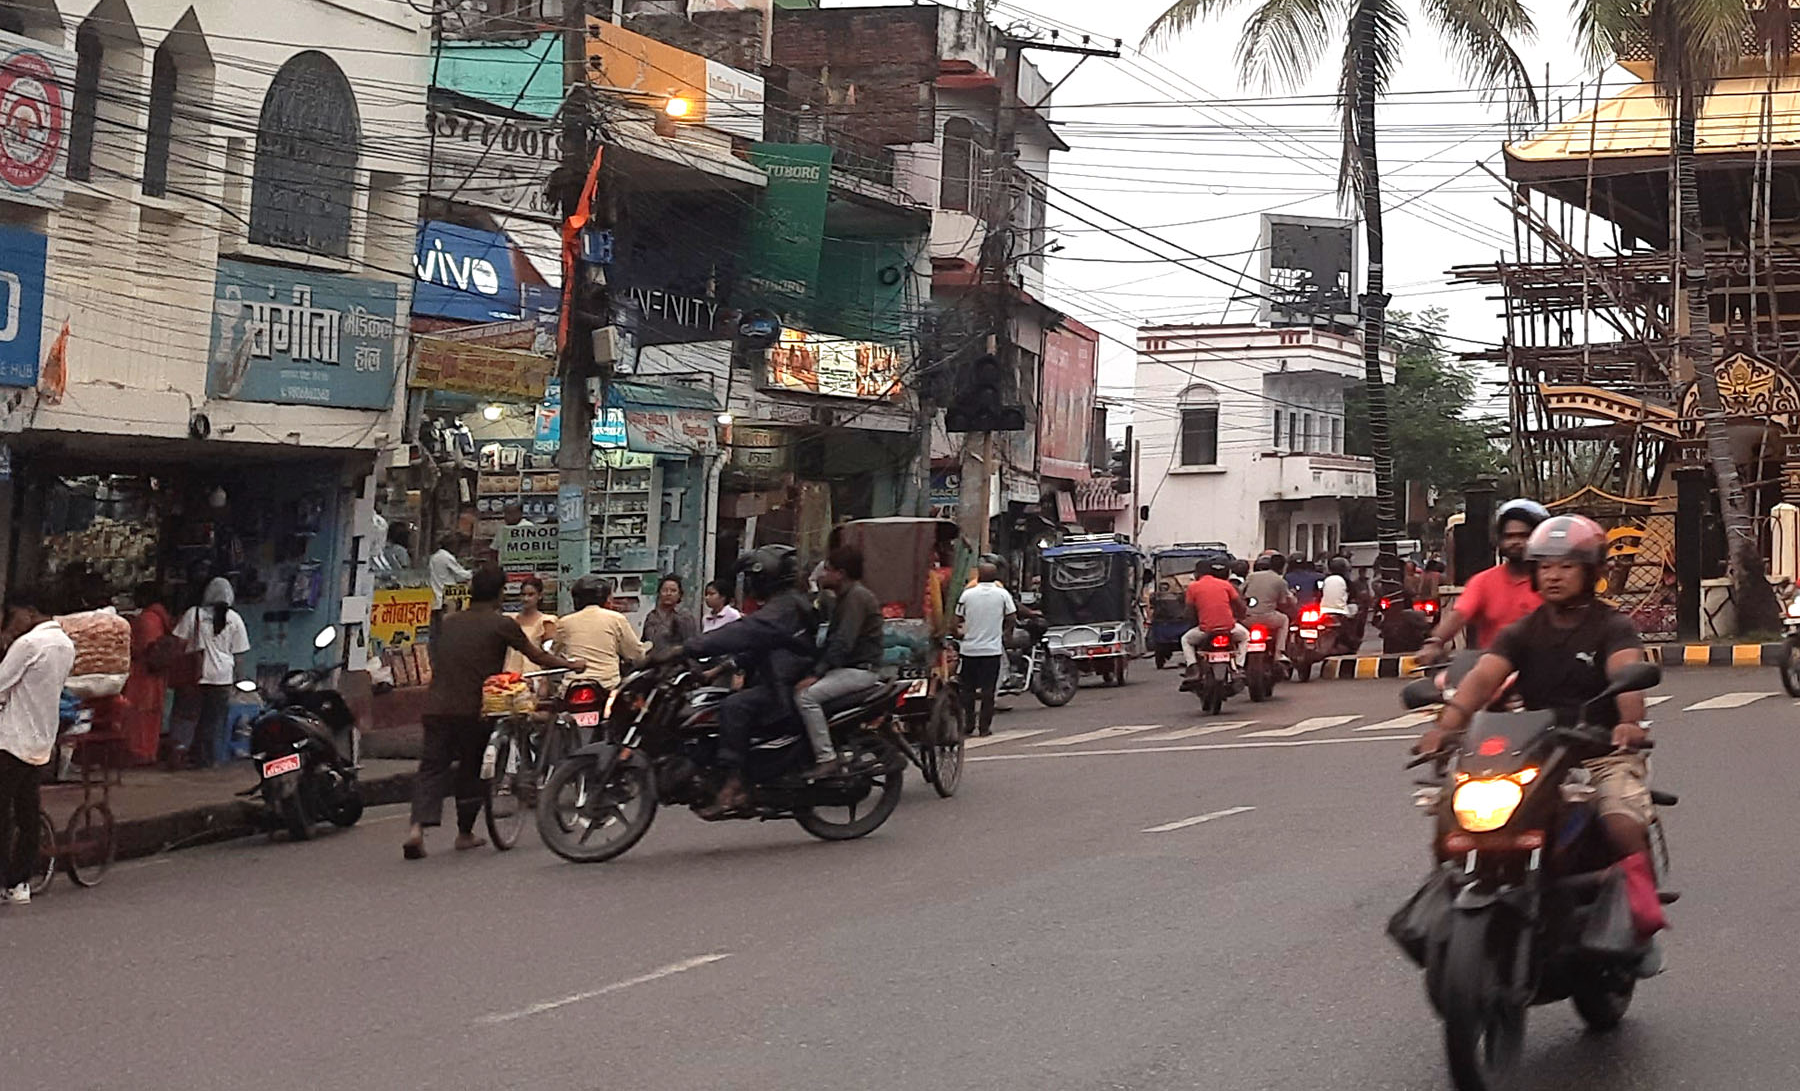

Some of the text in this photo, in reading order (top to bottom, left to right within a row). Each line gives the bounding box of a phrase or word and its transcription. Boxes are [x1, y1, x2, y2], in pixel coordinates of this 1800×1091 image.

[765, 164, 820, 181] TUBORG
[243, 283, 341, 365] संगीता
[511, 527, 559, 538] BINOD
